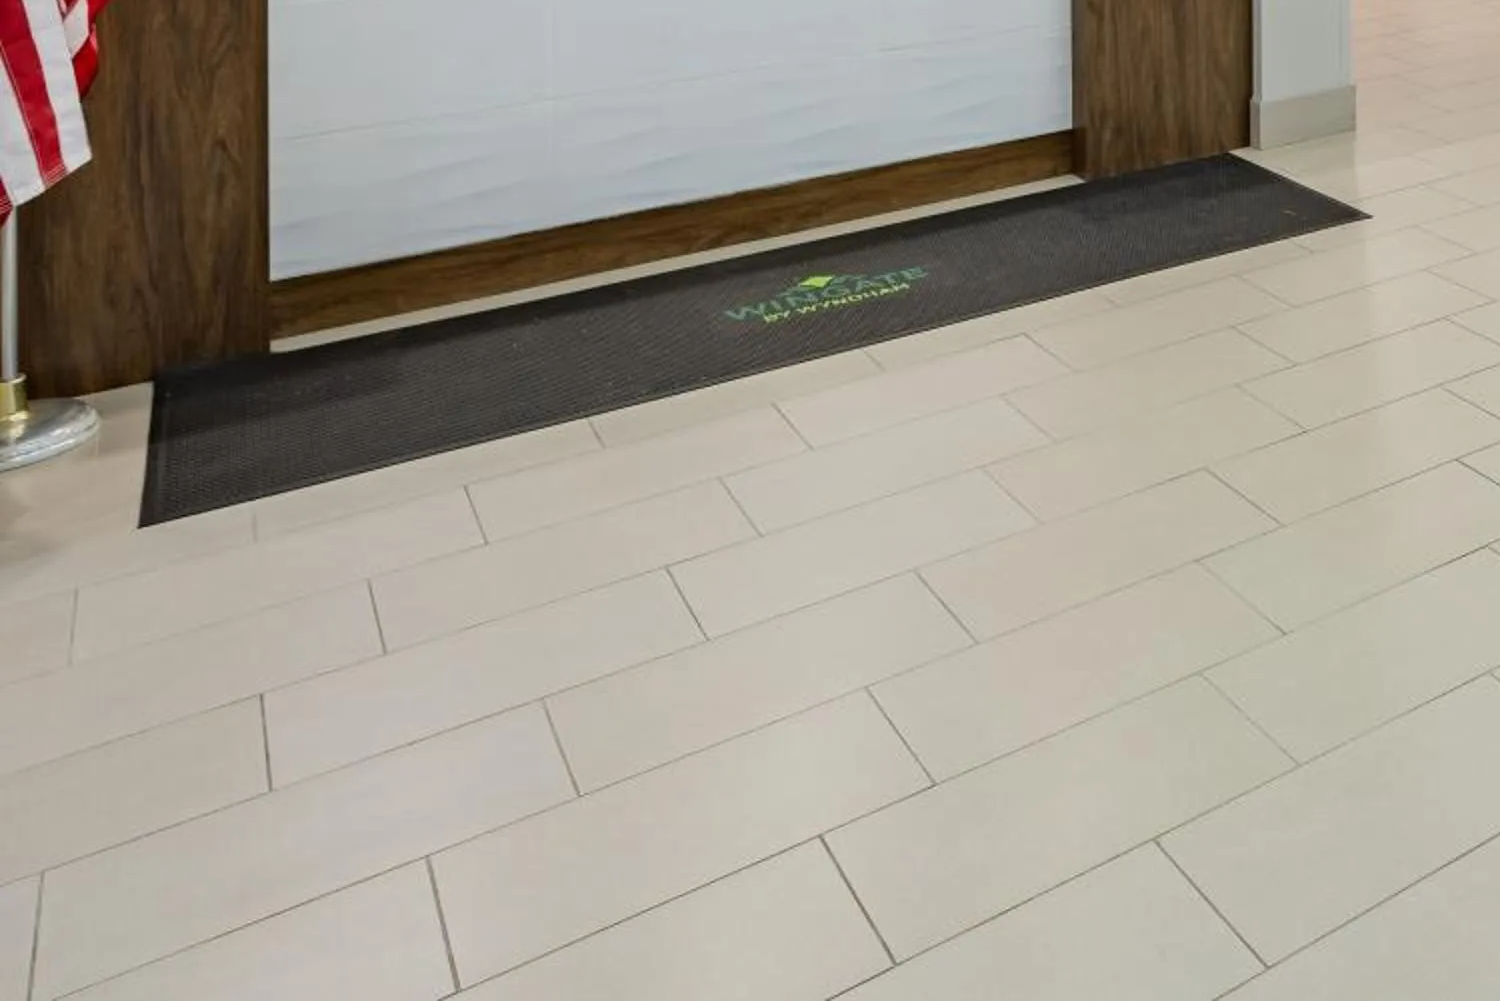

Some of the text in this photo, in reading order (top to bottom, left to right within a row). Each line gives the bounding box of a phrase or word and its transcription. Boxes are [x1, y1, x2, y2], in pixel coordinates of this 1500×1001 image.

[724, 266, 928, 321] WINGATE
[763, 283, 910, 323] BY WYNDHAM
